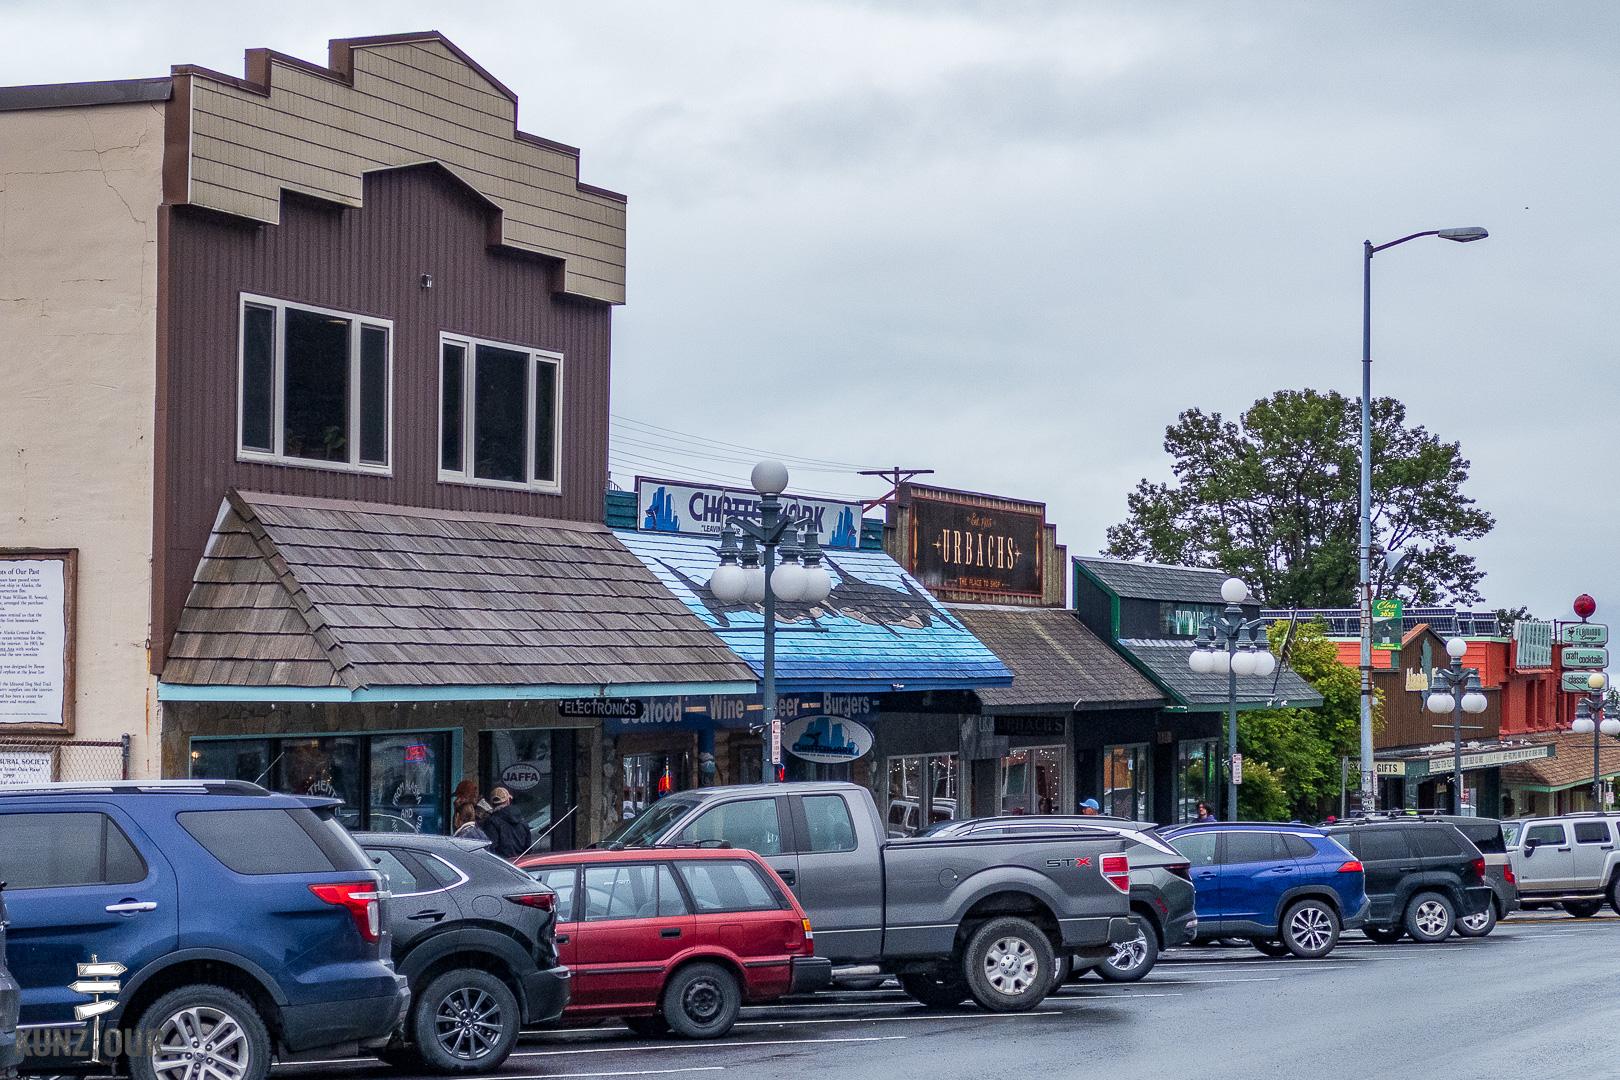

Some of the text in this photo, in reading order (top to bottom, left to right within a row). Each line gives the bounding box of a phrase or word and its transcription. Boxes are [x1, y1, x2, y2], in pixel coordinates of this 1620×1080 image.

[689, 492, 826, 533] CHATTEARK
[942, 528, 1014, 570] URBACHS
[1376, 601, 1398, 610] Class
[1565, 651, 1604, 664] craft cocktails
[1568, 675, 1588, 684] classic
[564, 701, 637, 716] ELECTRONICS
[620, 692, 870, 724] afood Wine eer Burgers
[1376, 763, 1398, 773] GIFTS
[503, 772, 539, 782] JAFFA
[1046, 856, 1092, 868] STX
